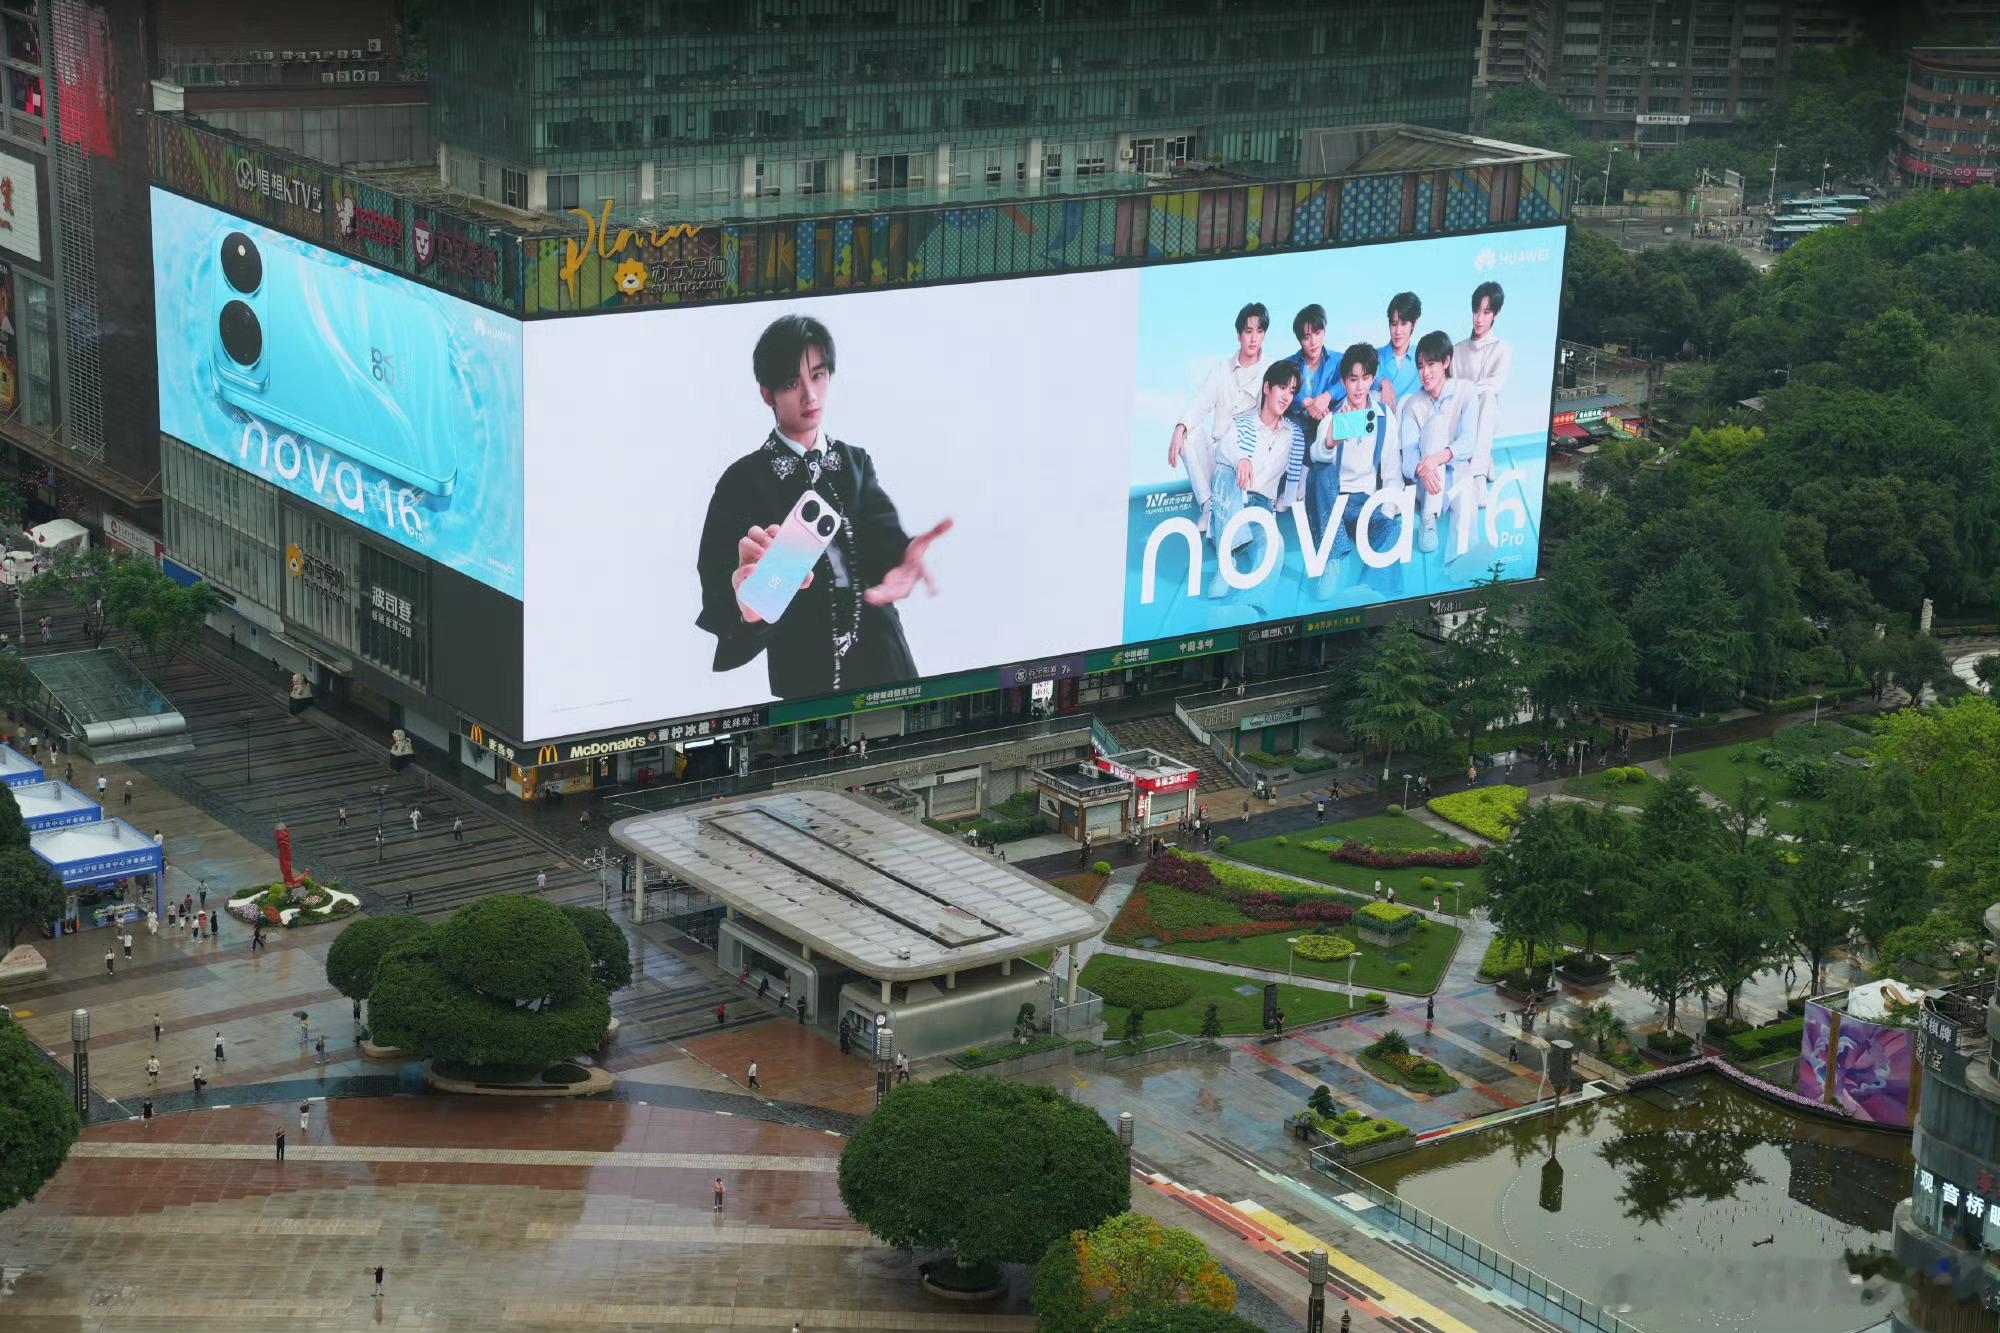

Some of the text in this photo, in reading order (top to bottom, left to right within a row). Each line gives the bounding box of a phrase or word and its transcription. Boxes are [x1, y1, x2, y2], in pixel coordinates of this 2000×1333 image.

[651, 255, 727, 282] 苏宁易购
[239, 420, 366, 515] nova
[1140, 485, 1417, 605] nova
[1500, 530, 1525, 547] Pro
[371, 585, 412, 624] 波司登
[488, 738, 515, 760] 麦当劳
[570, 736, 647, 759] McDonald's
